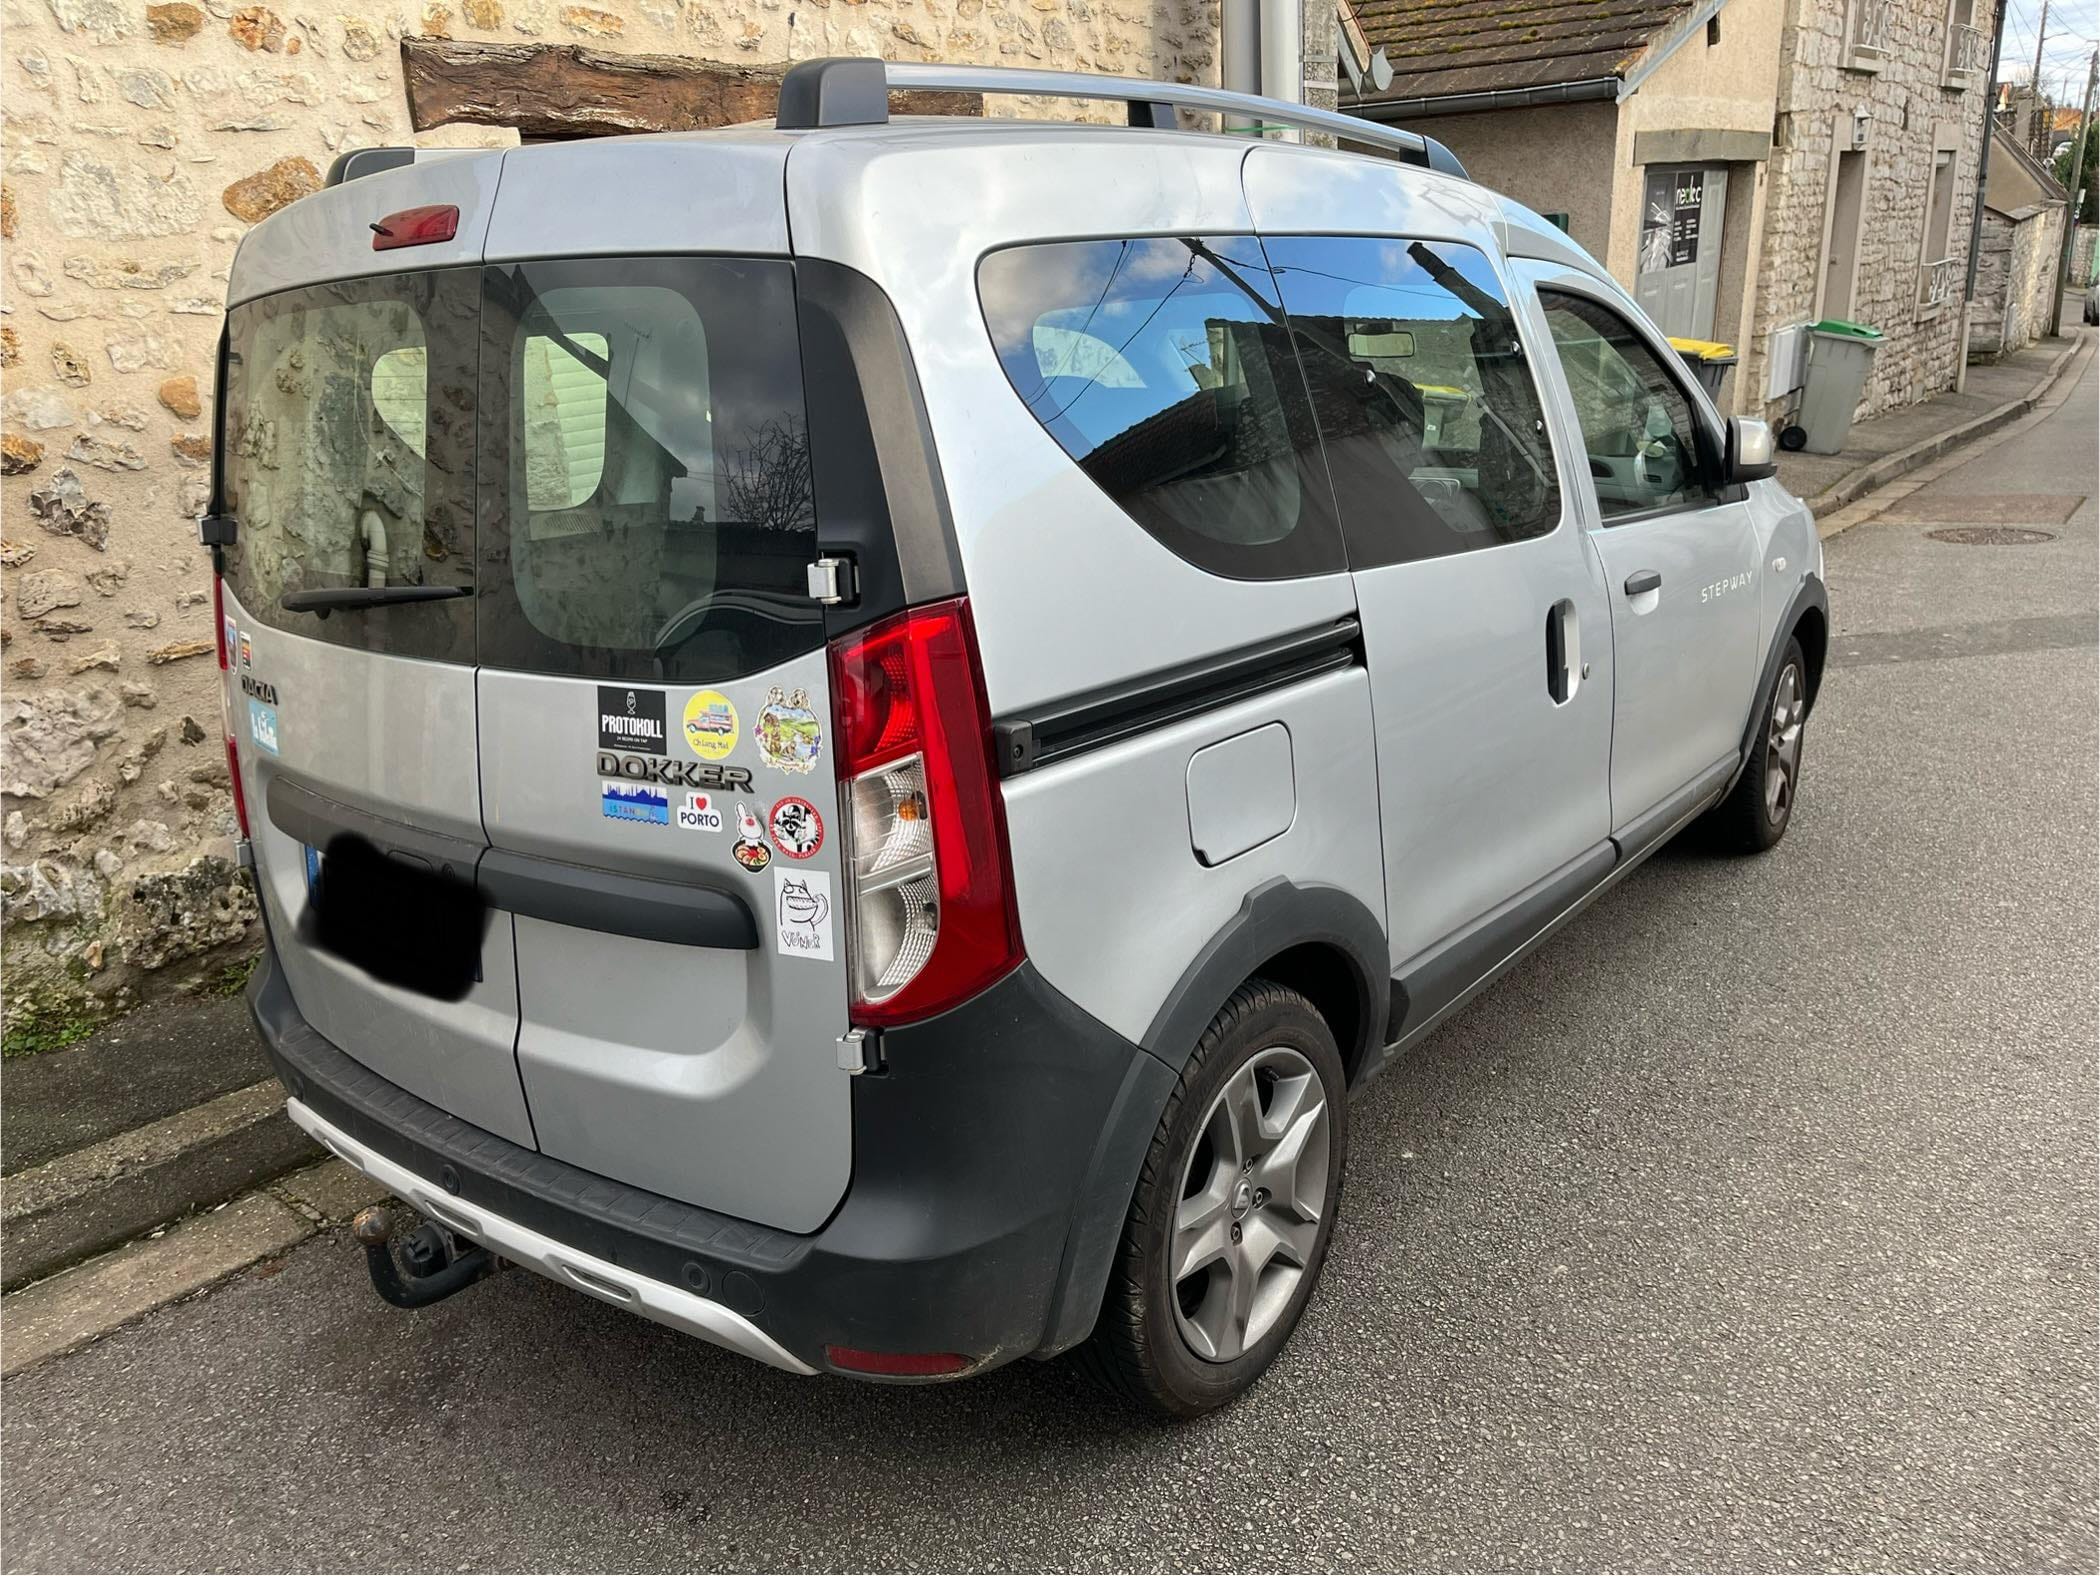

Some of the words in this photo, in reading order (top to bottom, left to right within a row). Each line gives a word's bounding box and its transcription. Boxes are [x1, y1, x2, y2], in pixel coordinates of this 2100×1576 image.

[1701, 570, 1753, 603] STEPWAY
[241, 674, 278, 706] DACIA
[601, 714, 663, 738] PROTOKOLL
[597, 751, 755, 793] DOKKER
[690, 796, 694, 809] I
[680, 811, 719, 828] PORTO
